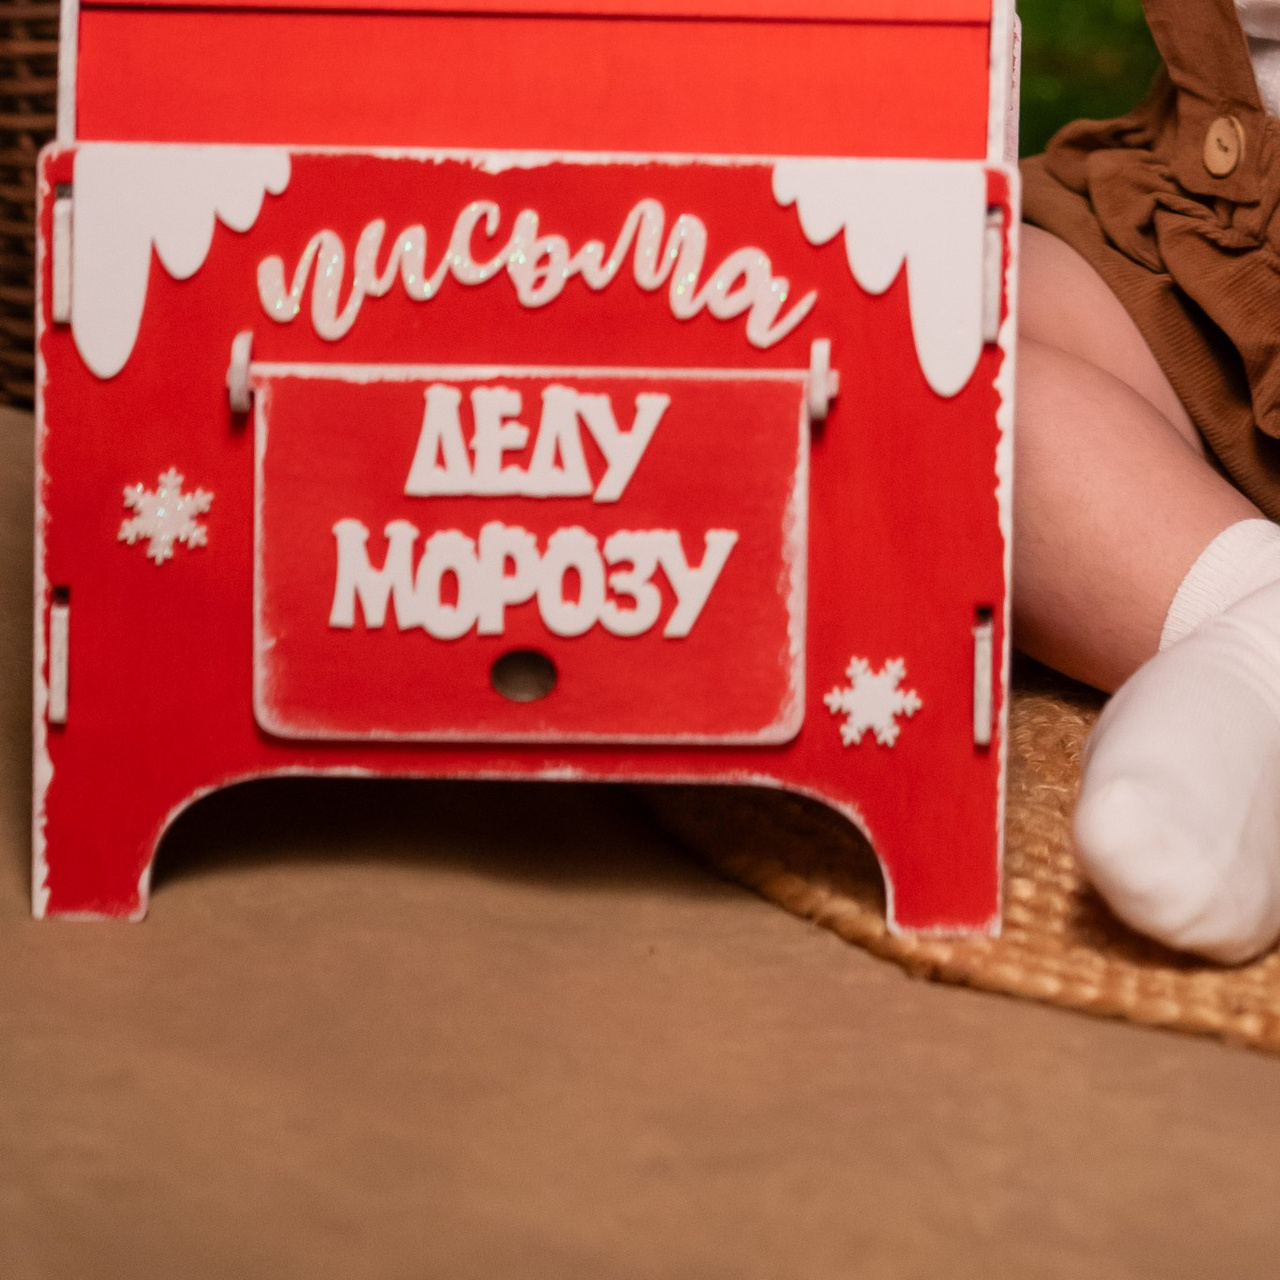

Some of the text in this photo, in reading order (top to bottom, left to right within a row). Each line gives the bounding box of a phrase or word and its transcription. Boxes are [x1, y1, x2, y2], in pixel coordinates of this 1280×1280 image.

[257, 199, 817, 348] письма
[404, 384, 671, 503] ДЕДУ
[328, 518, 739, 640] МОРОЗУ
